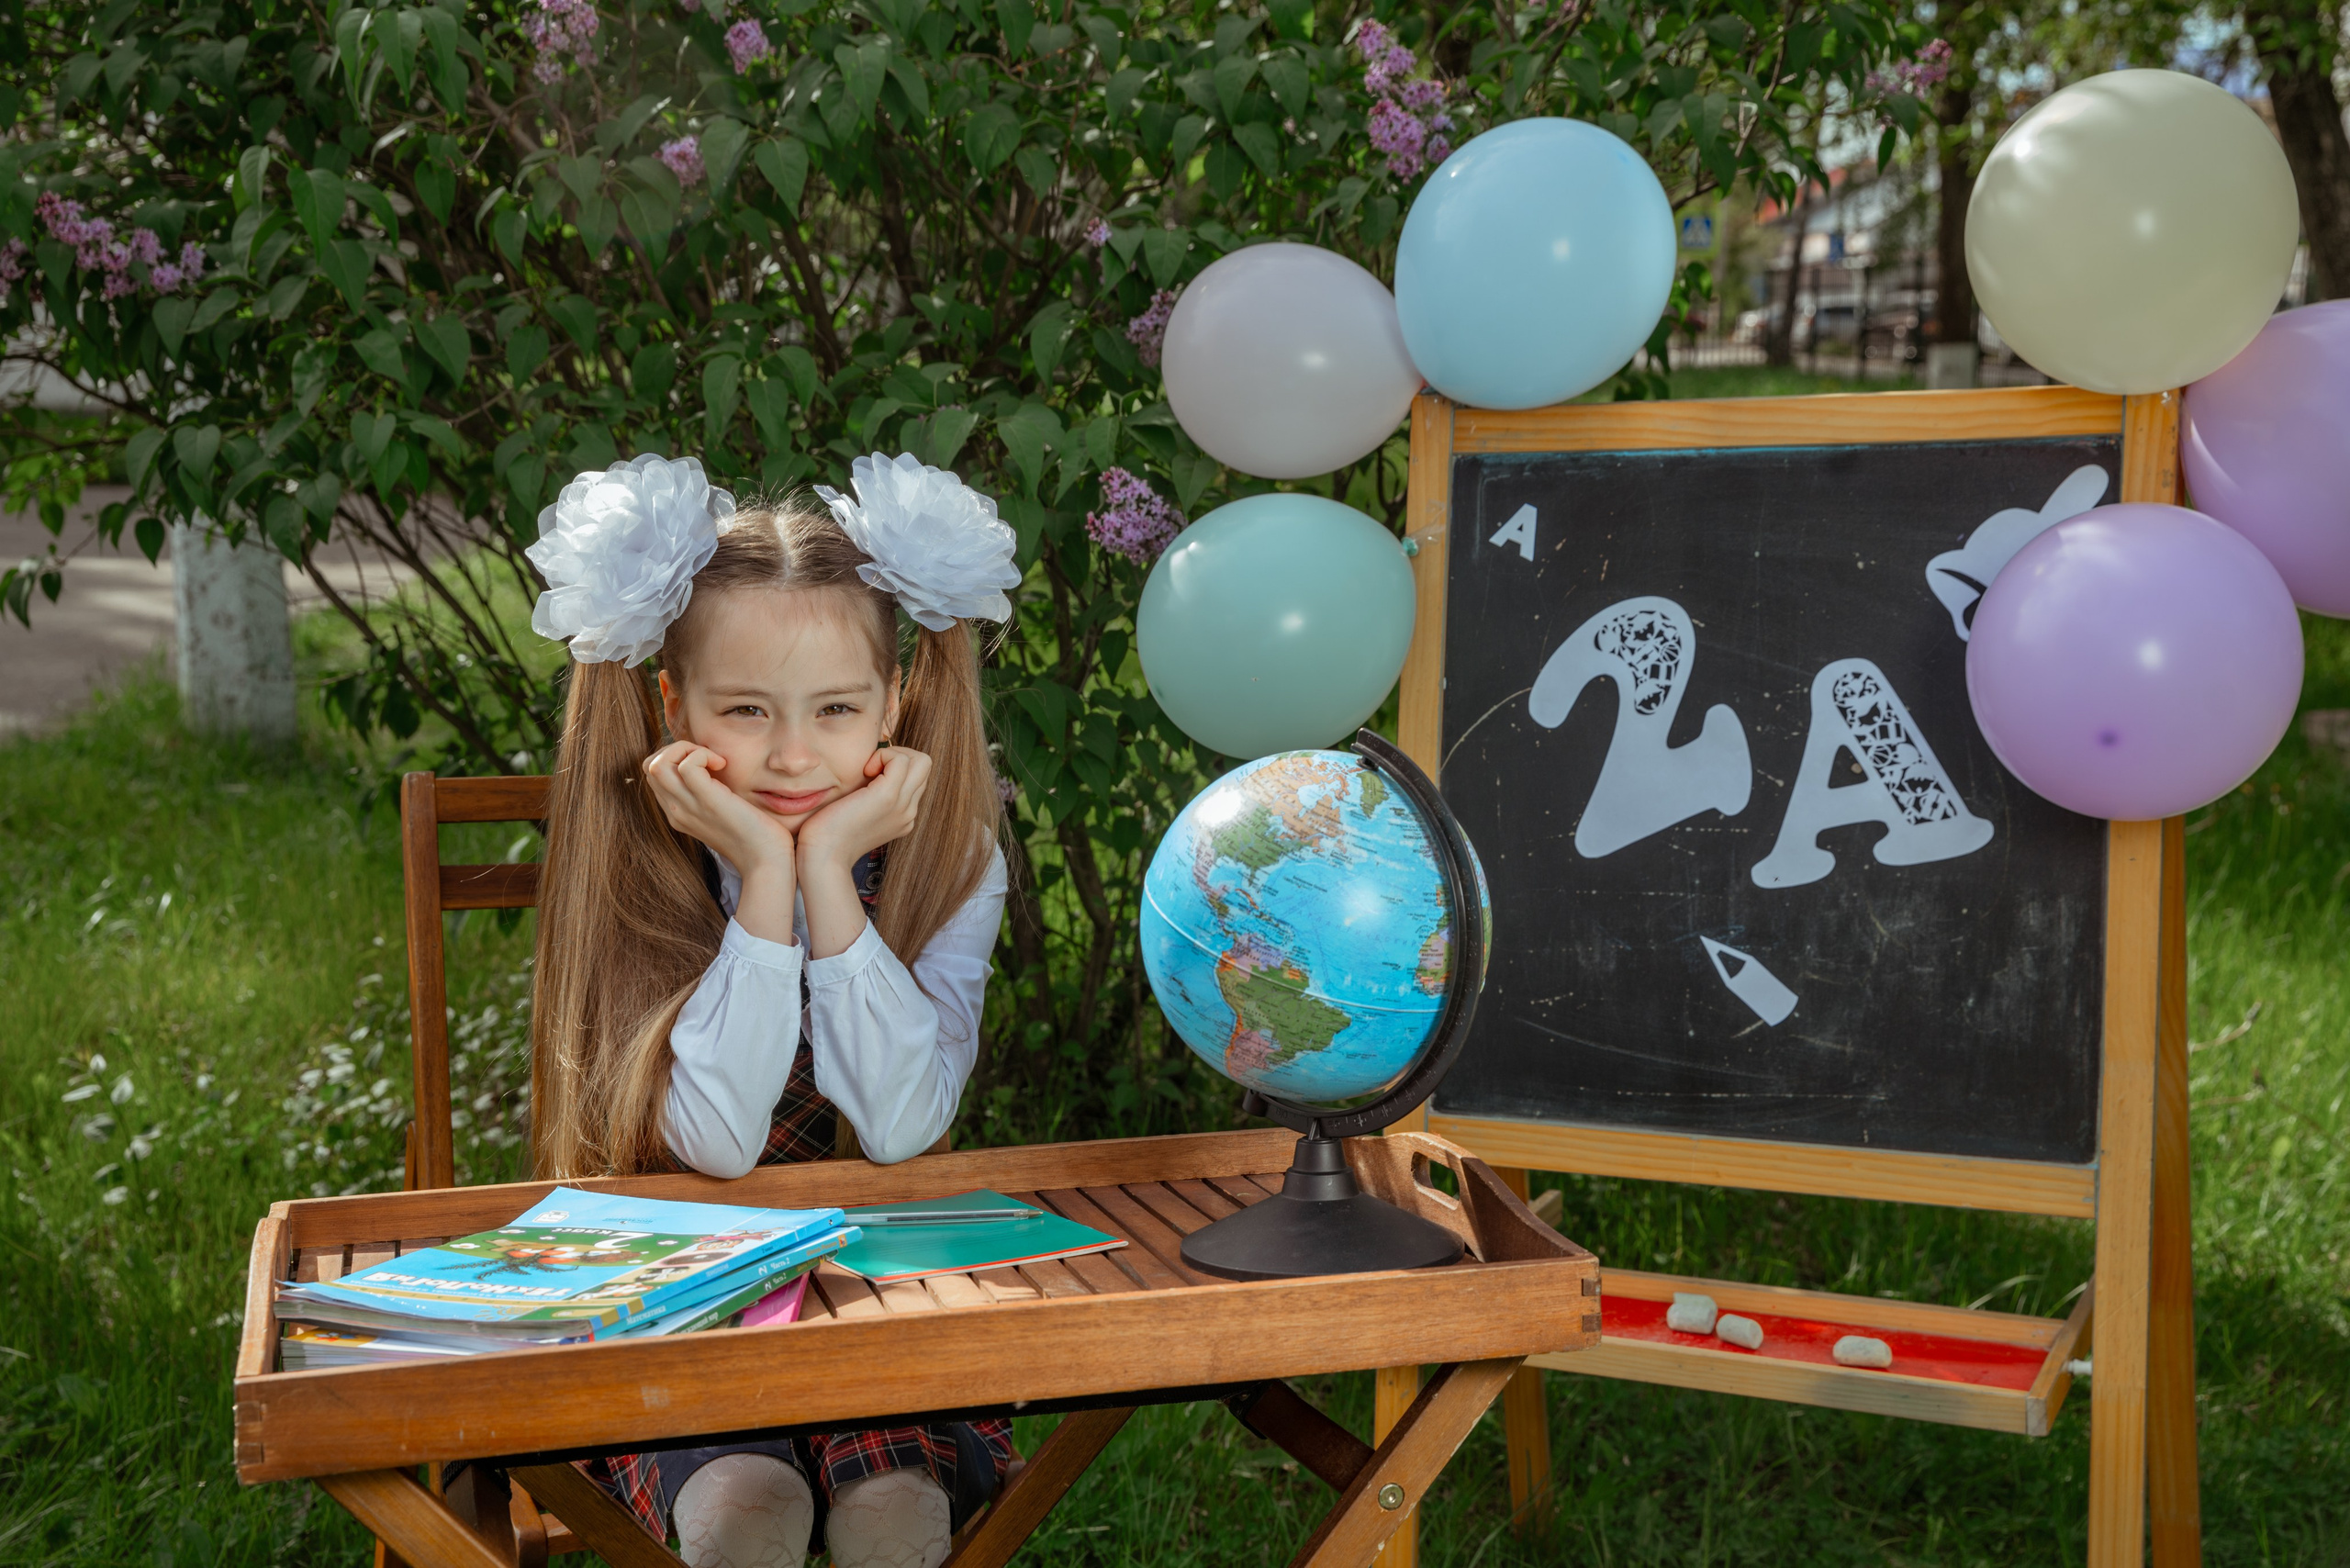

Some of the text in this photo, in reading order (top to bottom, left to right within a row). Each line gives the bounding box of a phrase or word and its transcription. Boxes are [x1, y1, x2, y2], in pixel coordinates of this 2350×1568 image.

[552, 1227, 654, 1249] 2 класс
[770, 1259, 786, 1270] Часть
[626, 1305, 666, 1325] Математика
